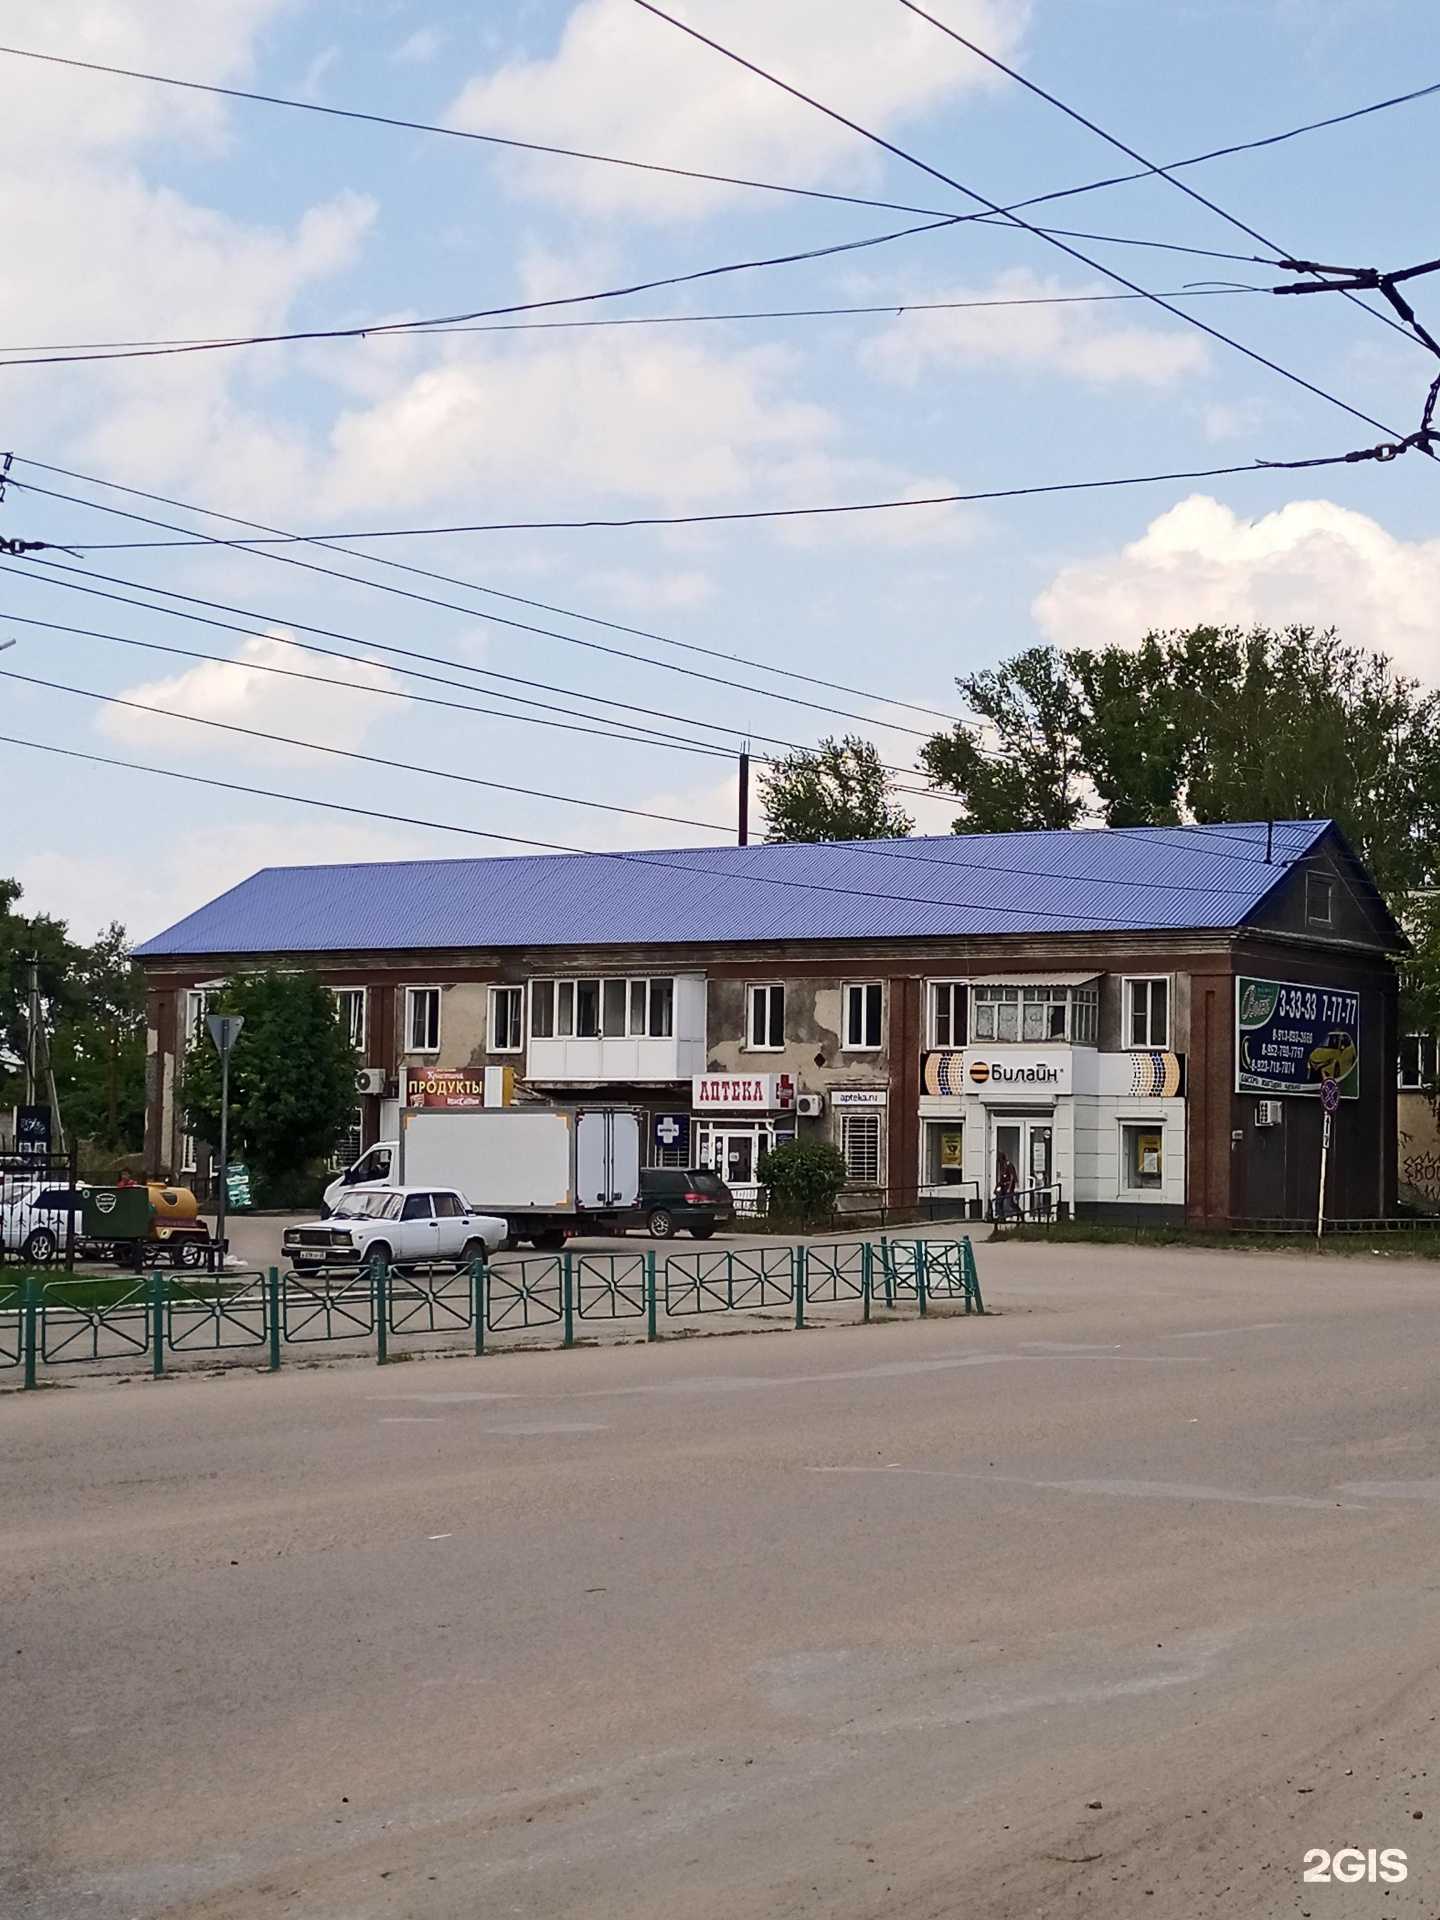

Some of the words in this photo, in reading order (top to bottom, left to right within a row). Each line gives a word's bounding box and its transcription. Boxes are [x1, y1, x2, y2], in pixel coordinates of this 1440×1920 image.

[1279, 989, 1317, 1020] 3-33-33
[1322, 995, 1357, 1025] 7-77-77
[991, 1063, 1058, 1082] Билайн
[408, 1080, 483, 1096] ПРОДУКТЫ
[699, 1080, 763, 1101] АПТЕКА
[839, 1092, 878, 1103] apteka.ru
